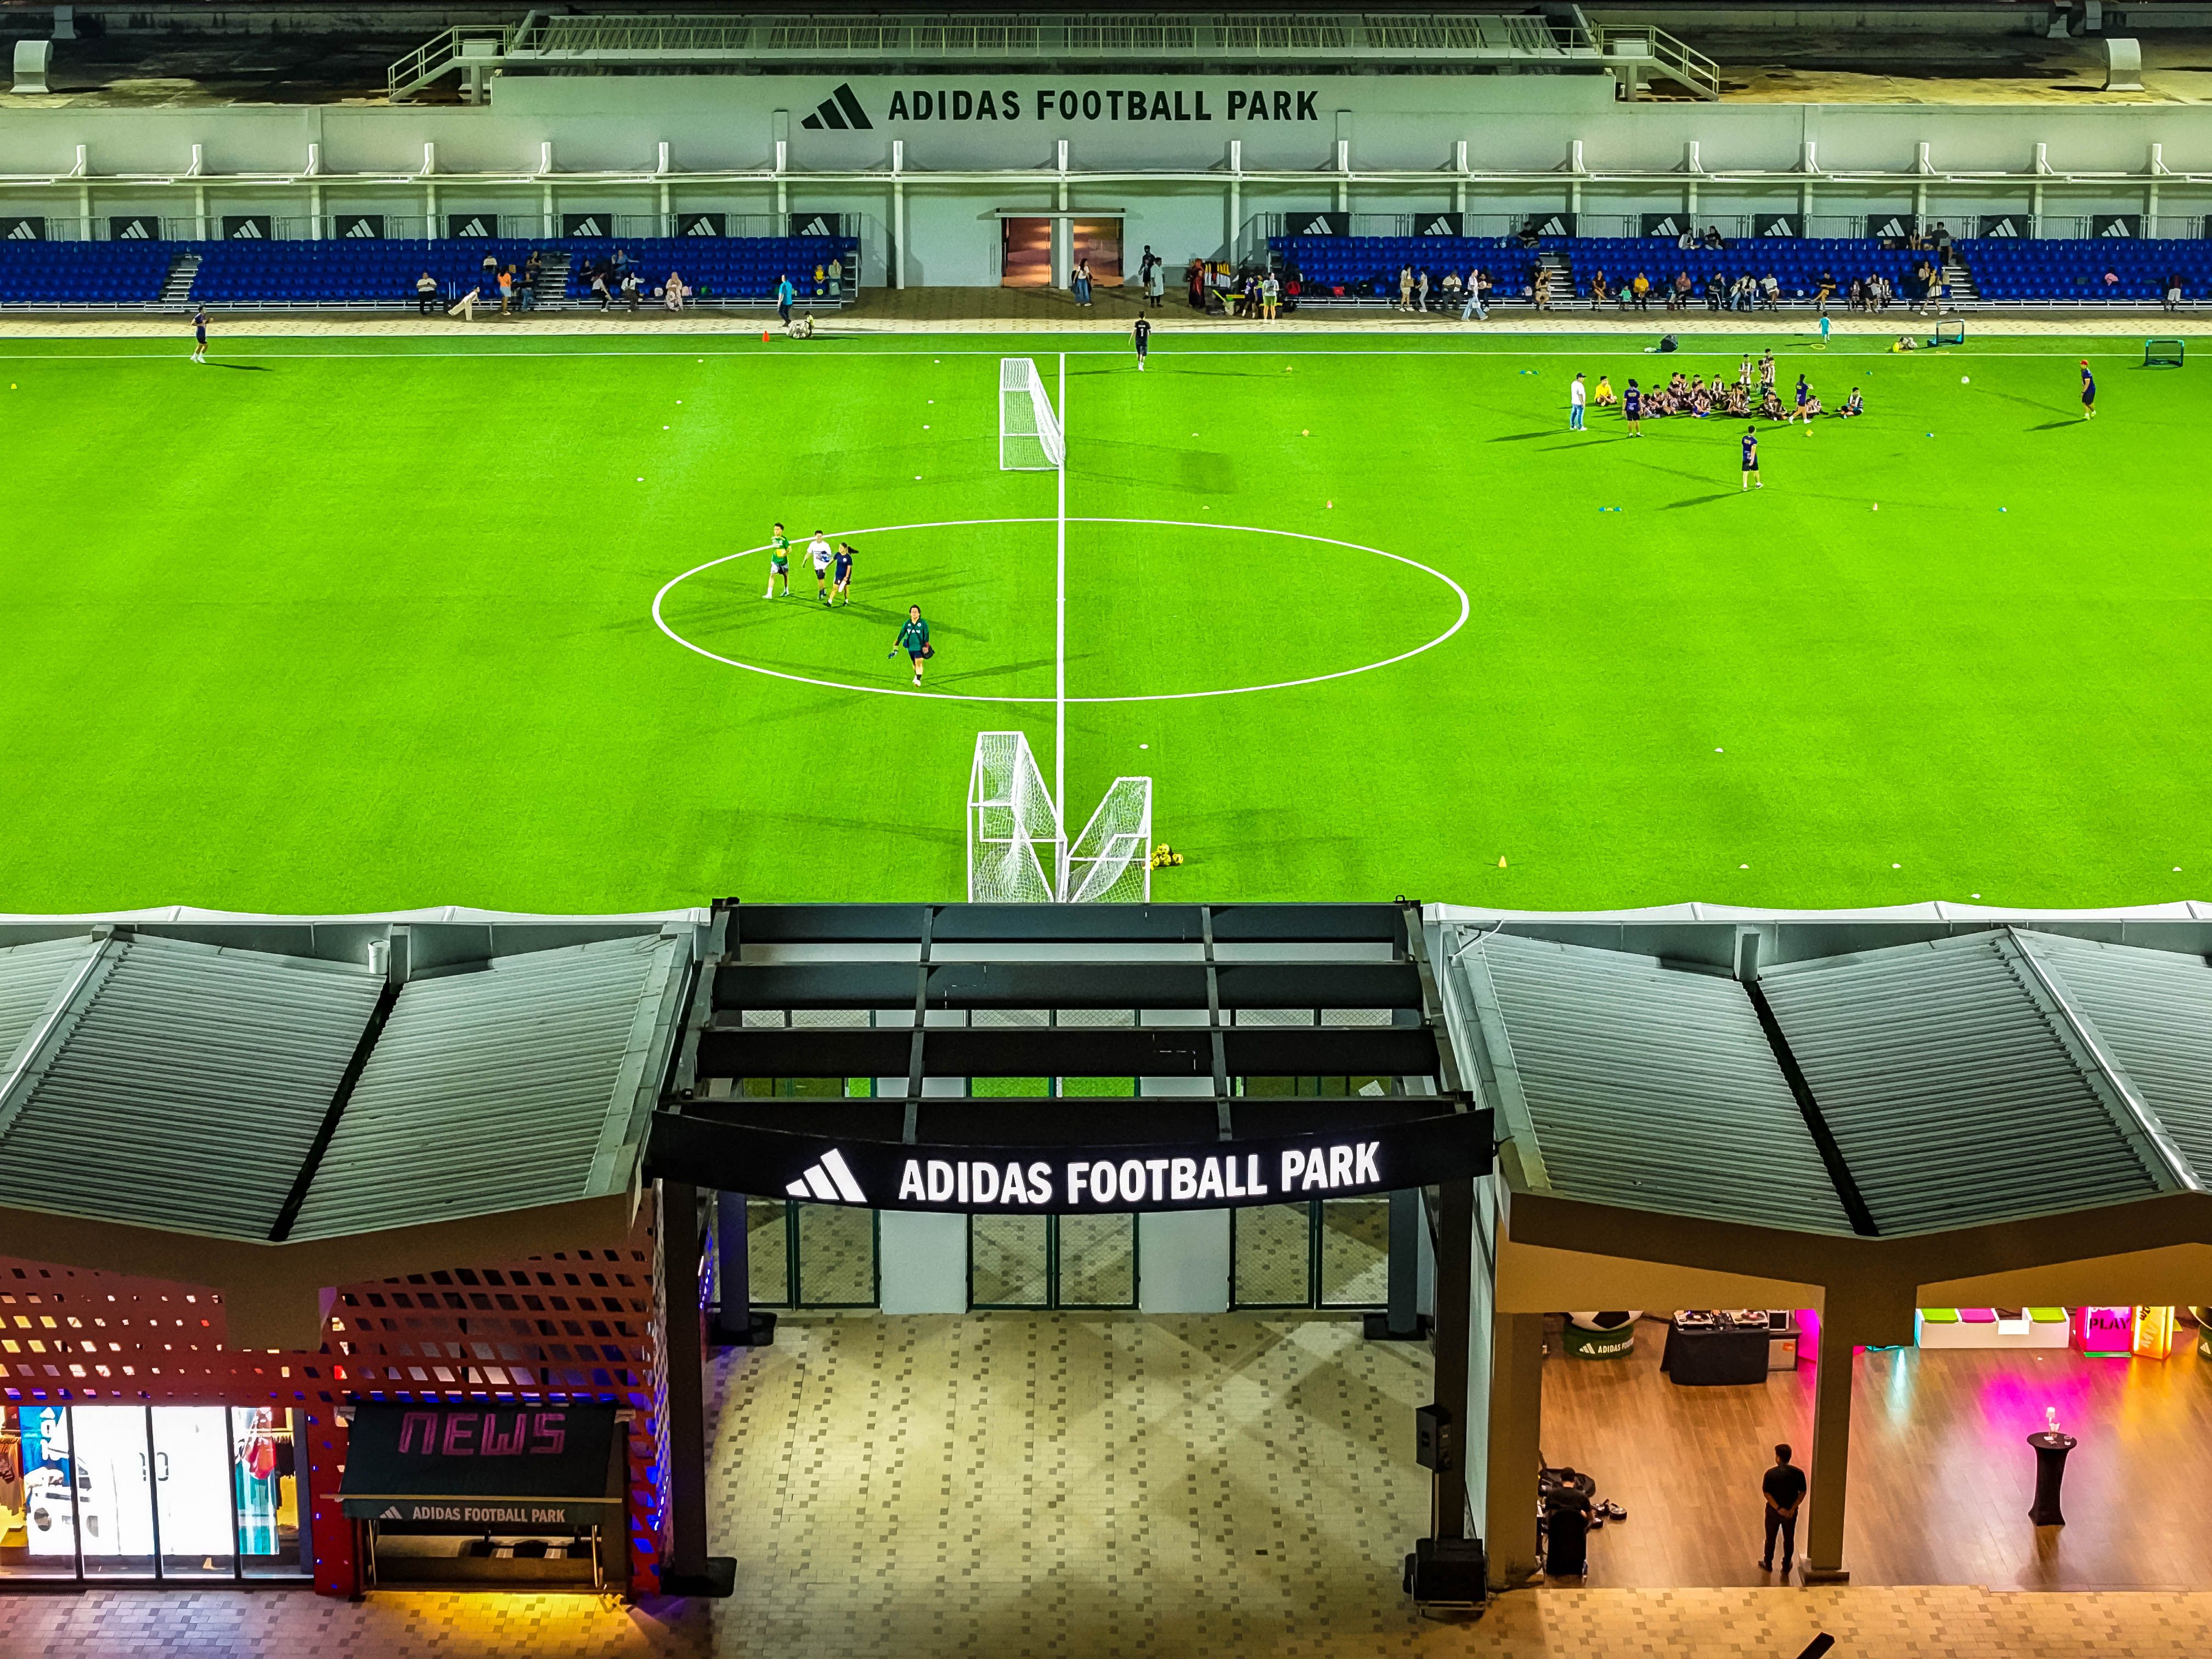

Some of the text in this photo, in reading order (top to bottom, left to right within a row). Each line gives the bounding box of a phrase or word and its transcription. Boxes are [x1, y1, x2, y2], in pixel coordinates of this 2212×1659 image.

[888, 90, 1319, 121] ADIDAS FOOTBALL PARK
[1140, 328, 1144, 337] 1
[898, 1142, 1381, 1205] ADIDAS FOOTBALL PARK
[2089, 1318, 2130, 1330] PLAY
[1598, 1344, 1621, 1353] ADIDAS
[413, 1506, 565, 1522] ADIDAS FOOTBALL PARK
